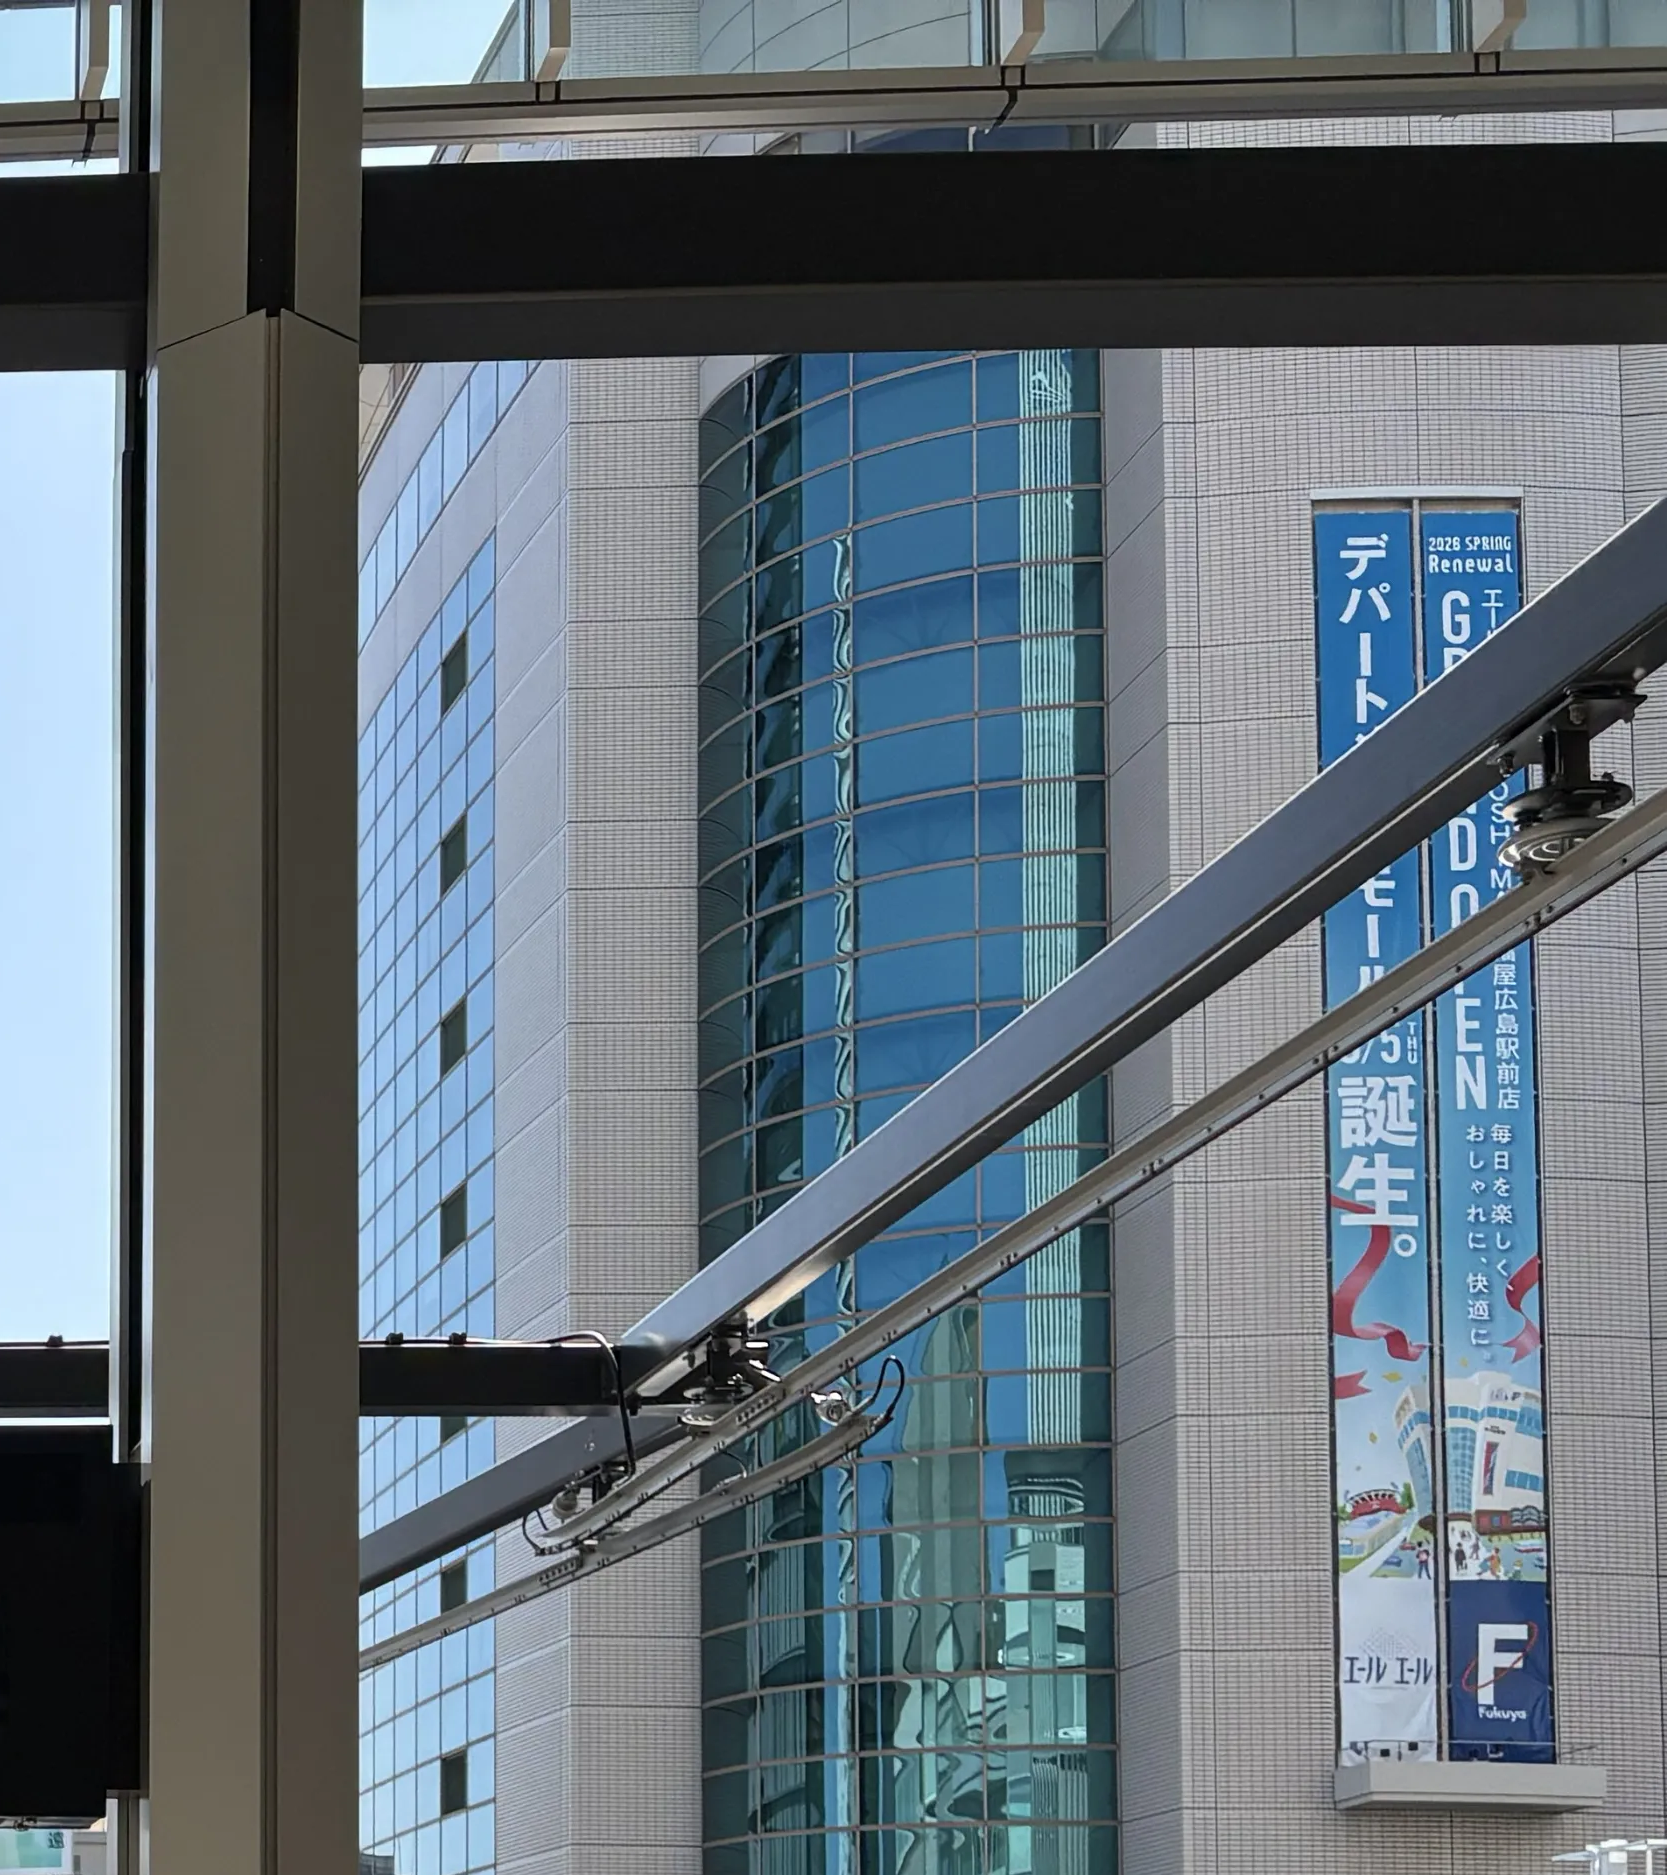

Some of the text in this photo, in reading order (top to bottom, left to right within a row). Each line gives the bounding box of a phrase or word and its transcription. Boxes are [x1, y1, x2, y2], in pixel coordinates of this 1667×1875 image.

[1428, 553, 1514, 574] Renewal
[1465, 535, 1512, 552] SPRING
[1337, 1075, 1419, 1257] 誕生。
[1490, 1123, 1515, 1291] 毎日を楽しく、
[1478, 1624, 1528, 1705] F
[1479, 1705, 1527, 1722] Fukuya
